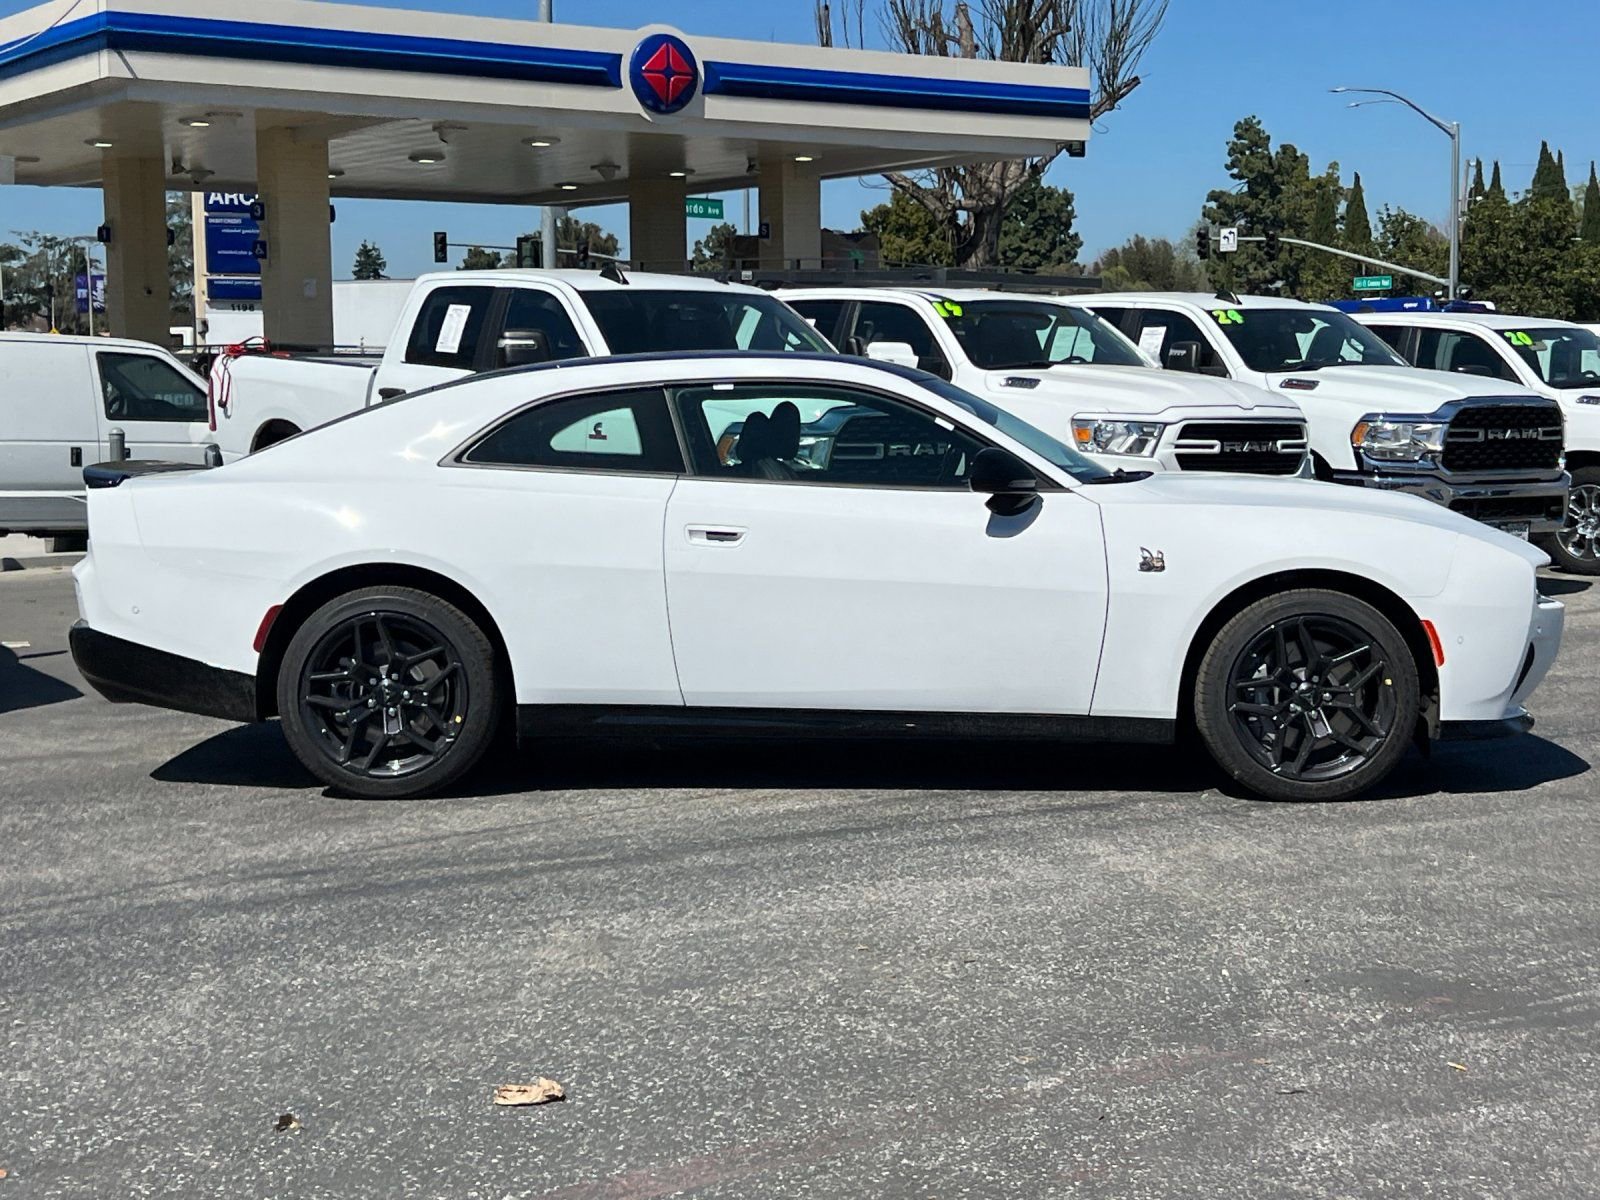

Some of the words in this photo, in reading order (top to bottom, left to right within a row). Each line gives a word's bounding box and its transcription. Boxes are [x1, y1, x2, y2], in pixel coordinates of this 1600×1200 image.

[208, 191, 259, 206] ARC
[708, 206, 720, 216] Ave
[1487, 428, 1538, 440] RAM
[1223, 440, 1278, 453] RAM
